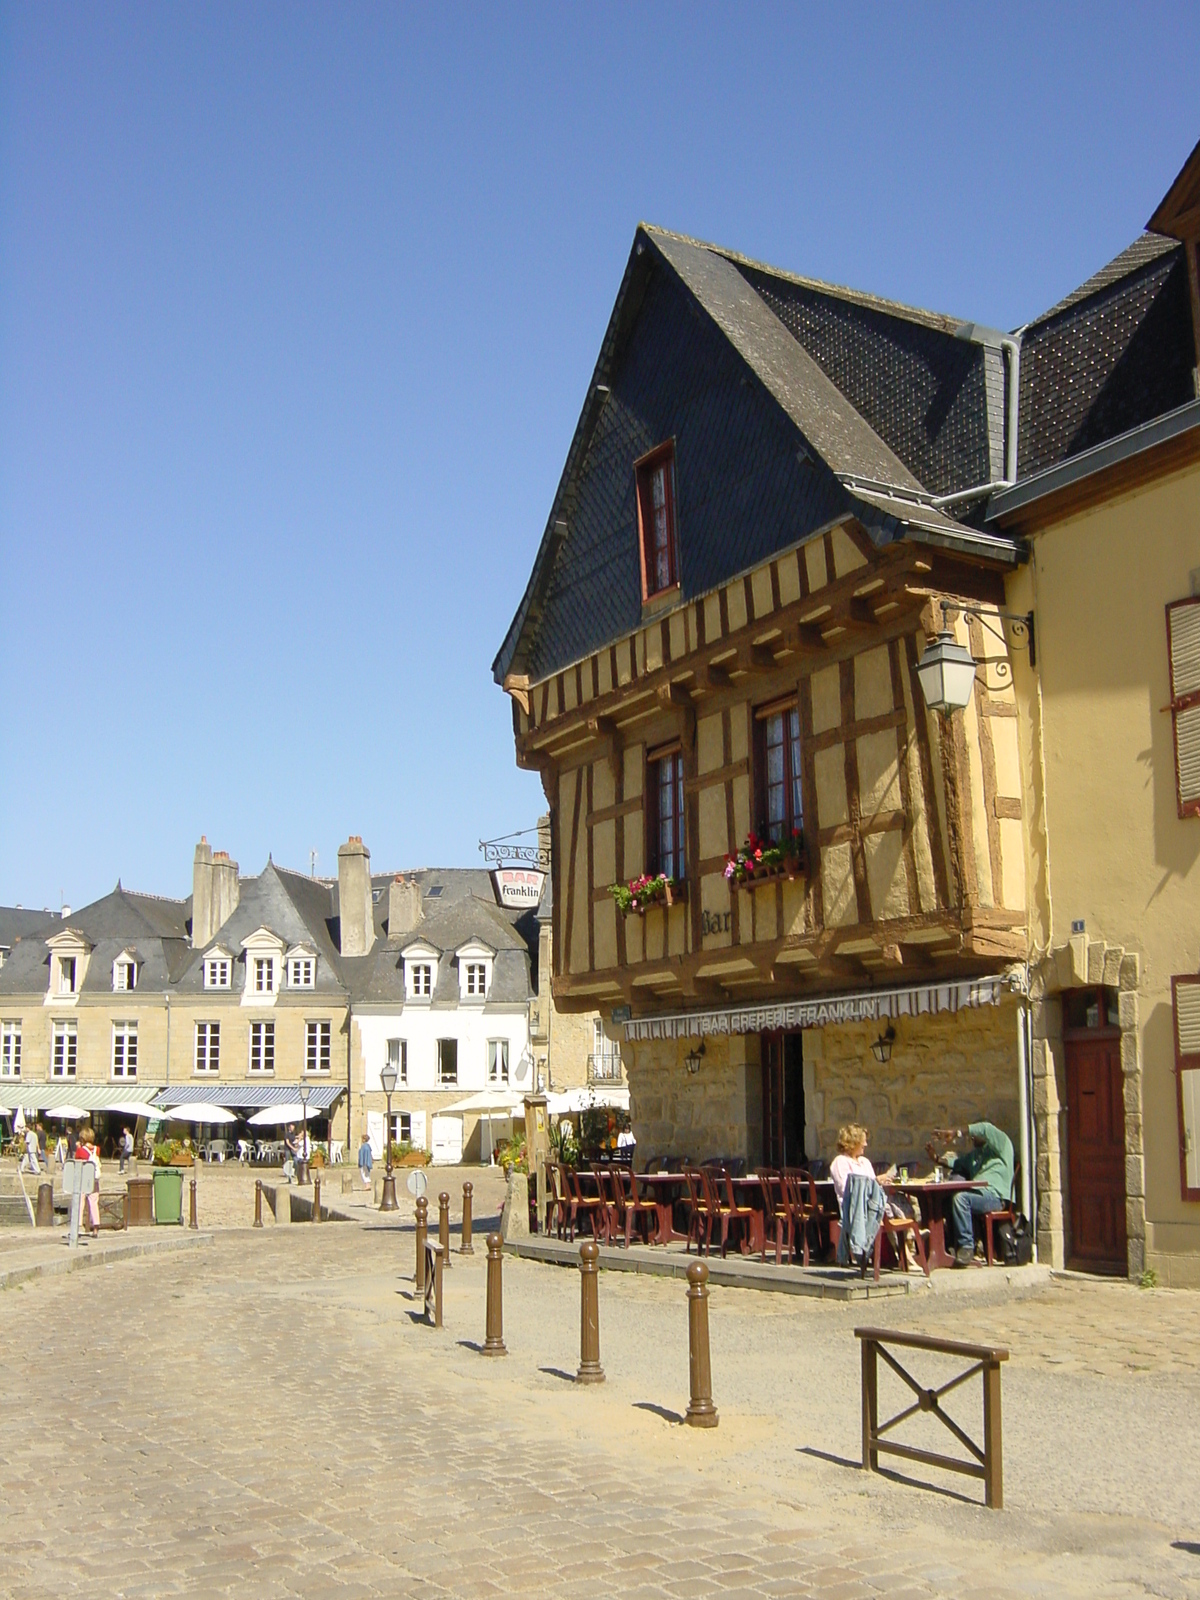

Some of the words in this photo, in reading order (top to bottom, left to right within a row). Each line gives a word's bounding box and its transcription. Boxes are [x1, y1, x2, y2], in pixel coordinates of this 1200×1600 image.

[502, 872, 539, 885] BAR
[502, 884, 539, 897] franklin
[702, 909, 731, 936] Bar
[731, 1009, 795, 1029] CREPERIE
